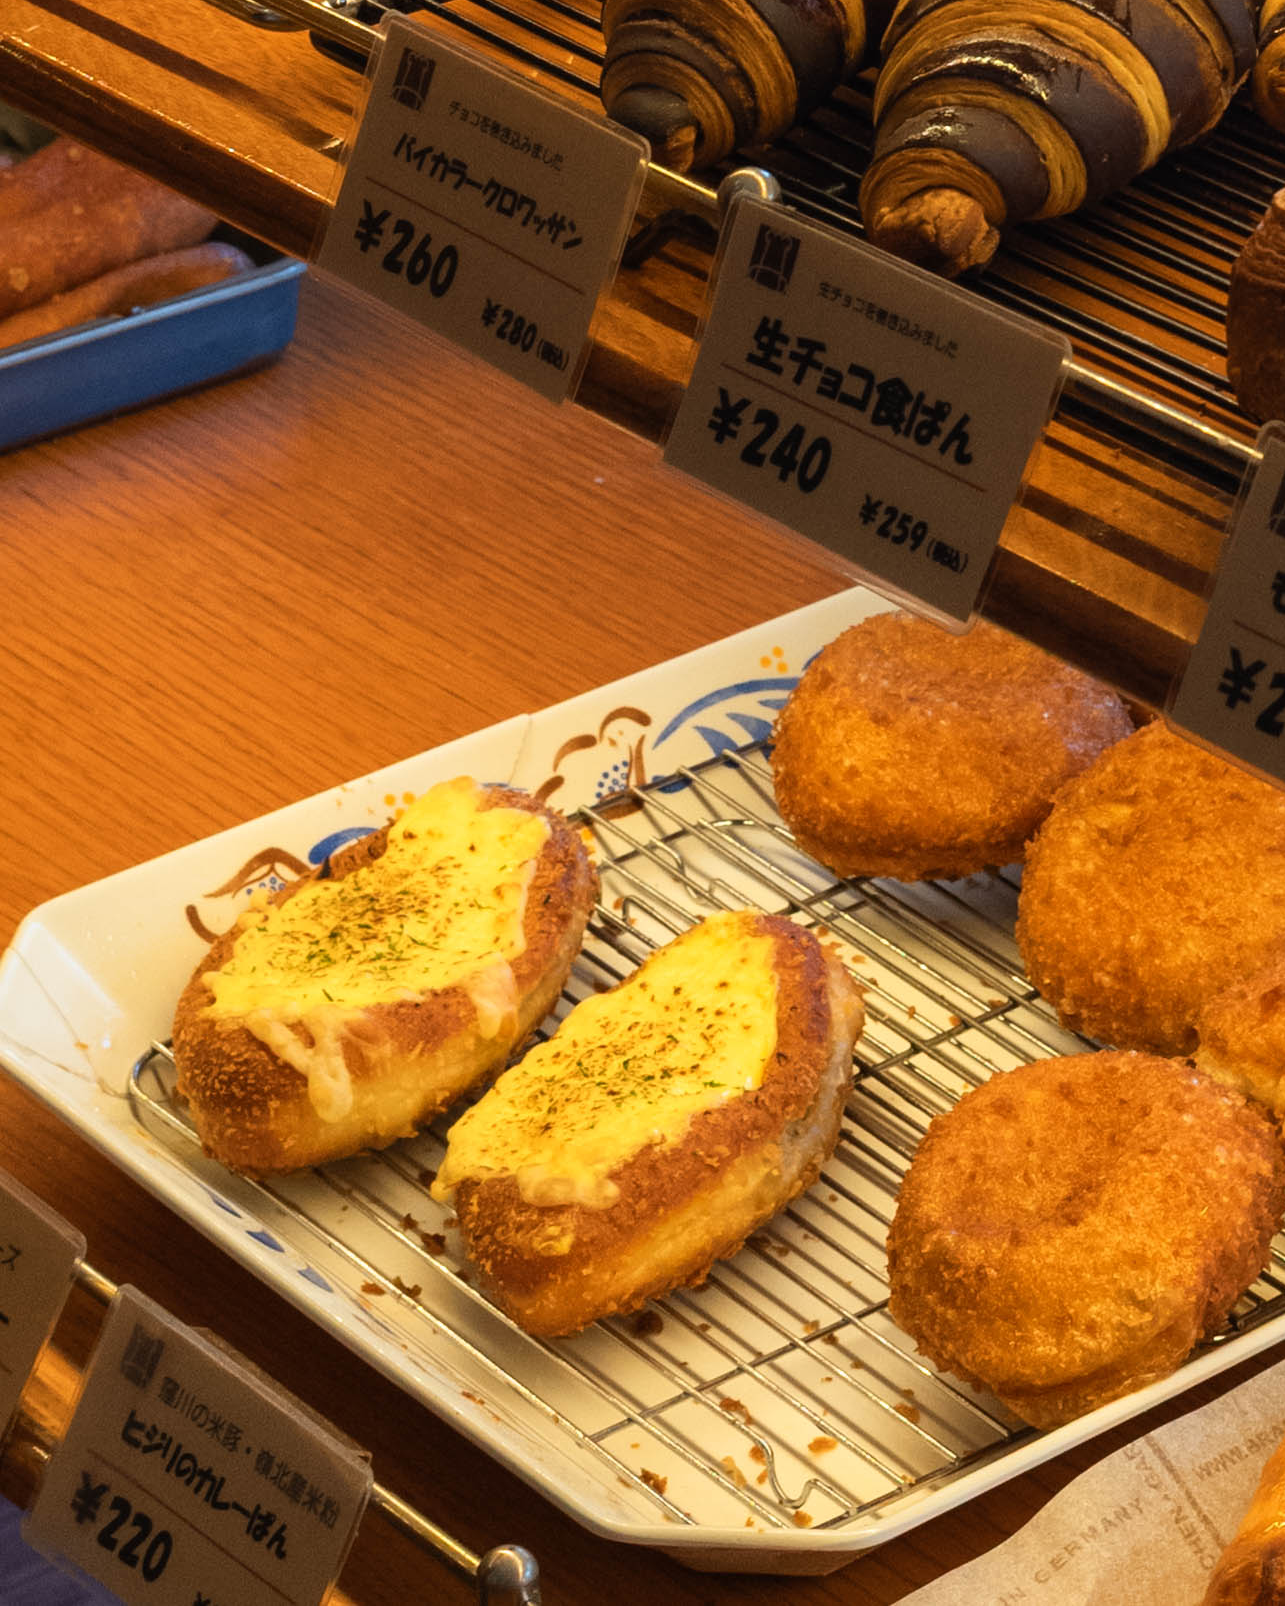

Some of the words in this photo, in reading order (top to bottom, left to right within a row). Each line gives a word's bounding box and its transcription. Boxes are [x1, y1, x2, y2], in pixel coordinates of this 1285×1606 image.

[393, 132, 583, 250] バイカラークロワッサン
[354, 199, 459, 297] ¥260
[707, 386, 832, 494] ¥240
[745, 315, 974, 466] 生チョコ食ぱん
[70, 1470, 173, 1583] ¥220
[1033, 1497, 1144, 1587] GERMANY
